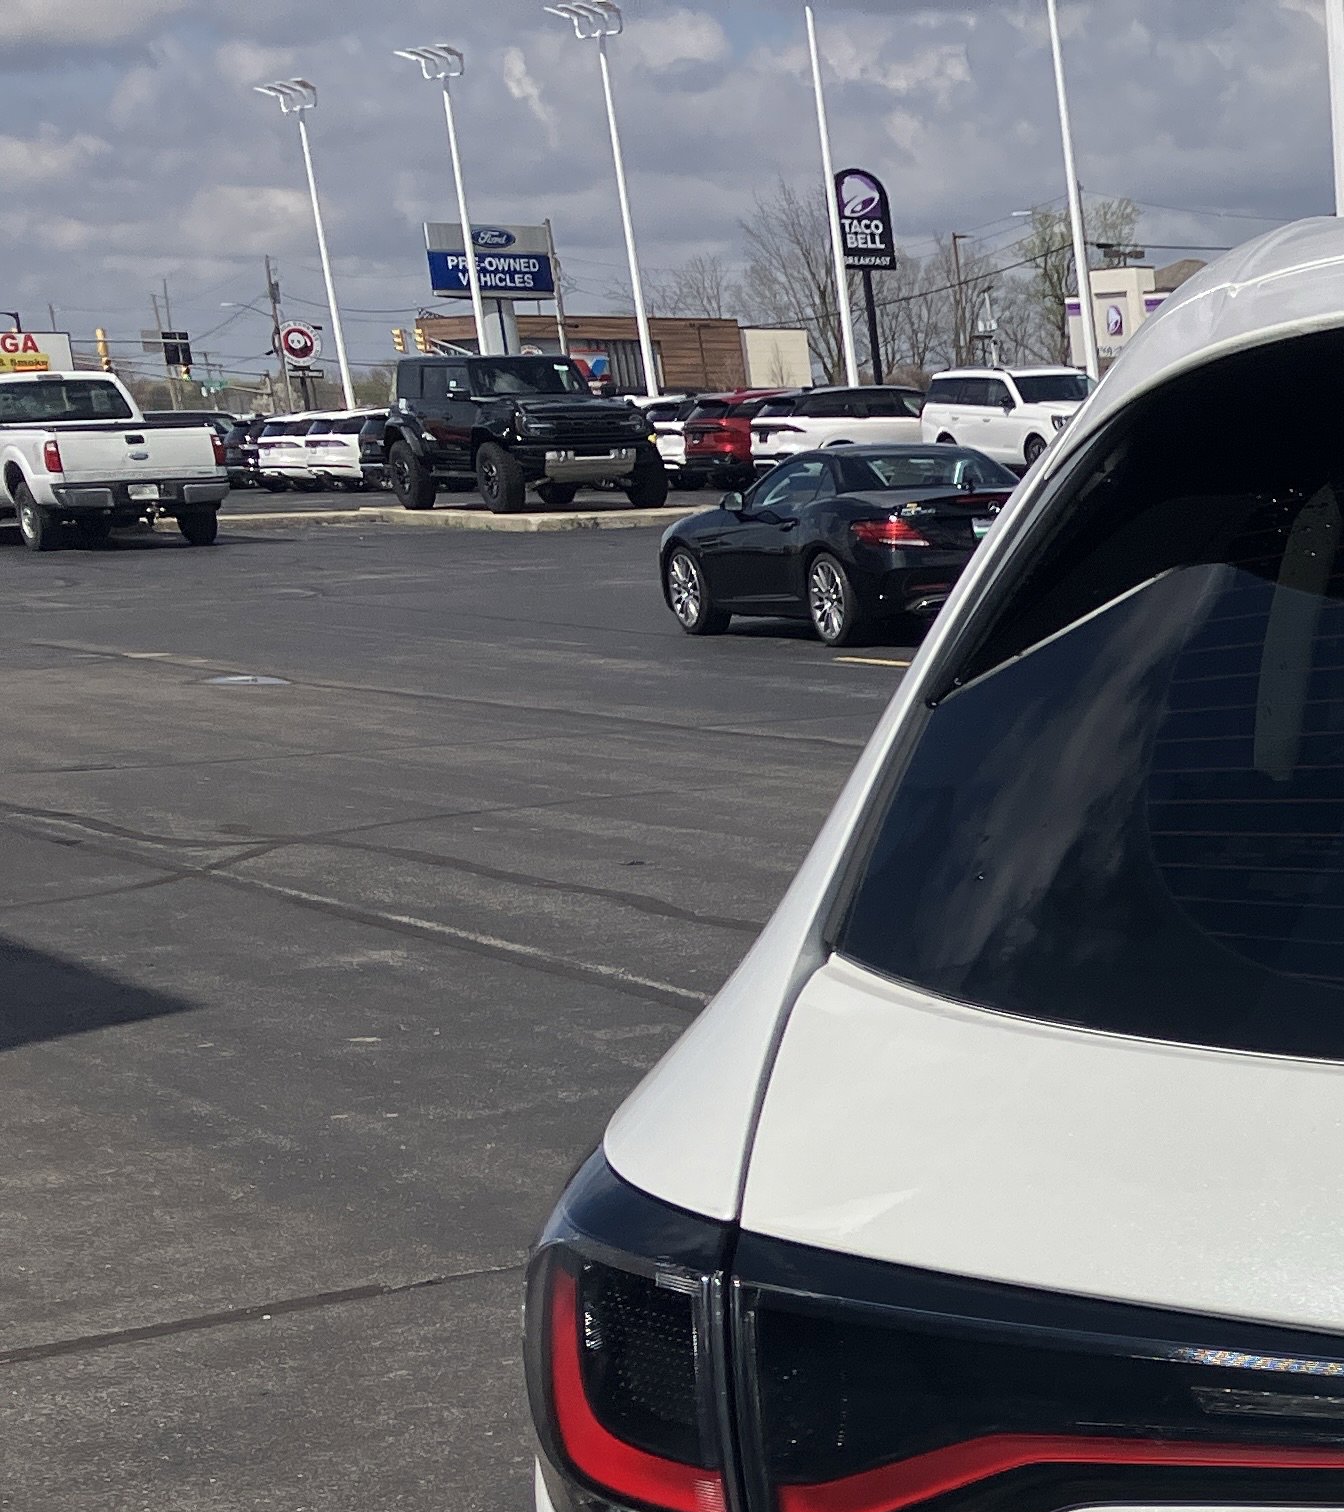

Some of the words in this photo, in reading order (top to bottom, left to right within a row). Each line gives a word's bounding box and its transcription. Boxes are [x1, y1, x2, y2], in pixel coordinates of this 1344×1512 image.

[841, 218, 883, 234] TACO
[478, 231, 507, 244] Ford
[847, 234, 885, 249] BELL
[458, 272, 534, 287] VHICLES
